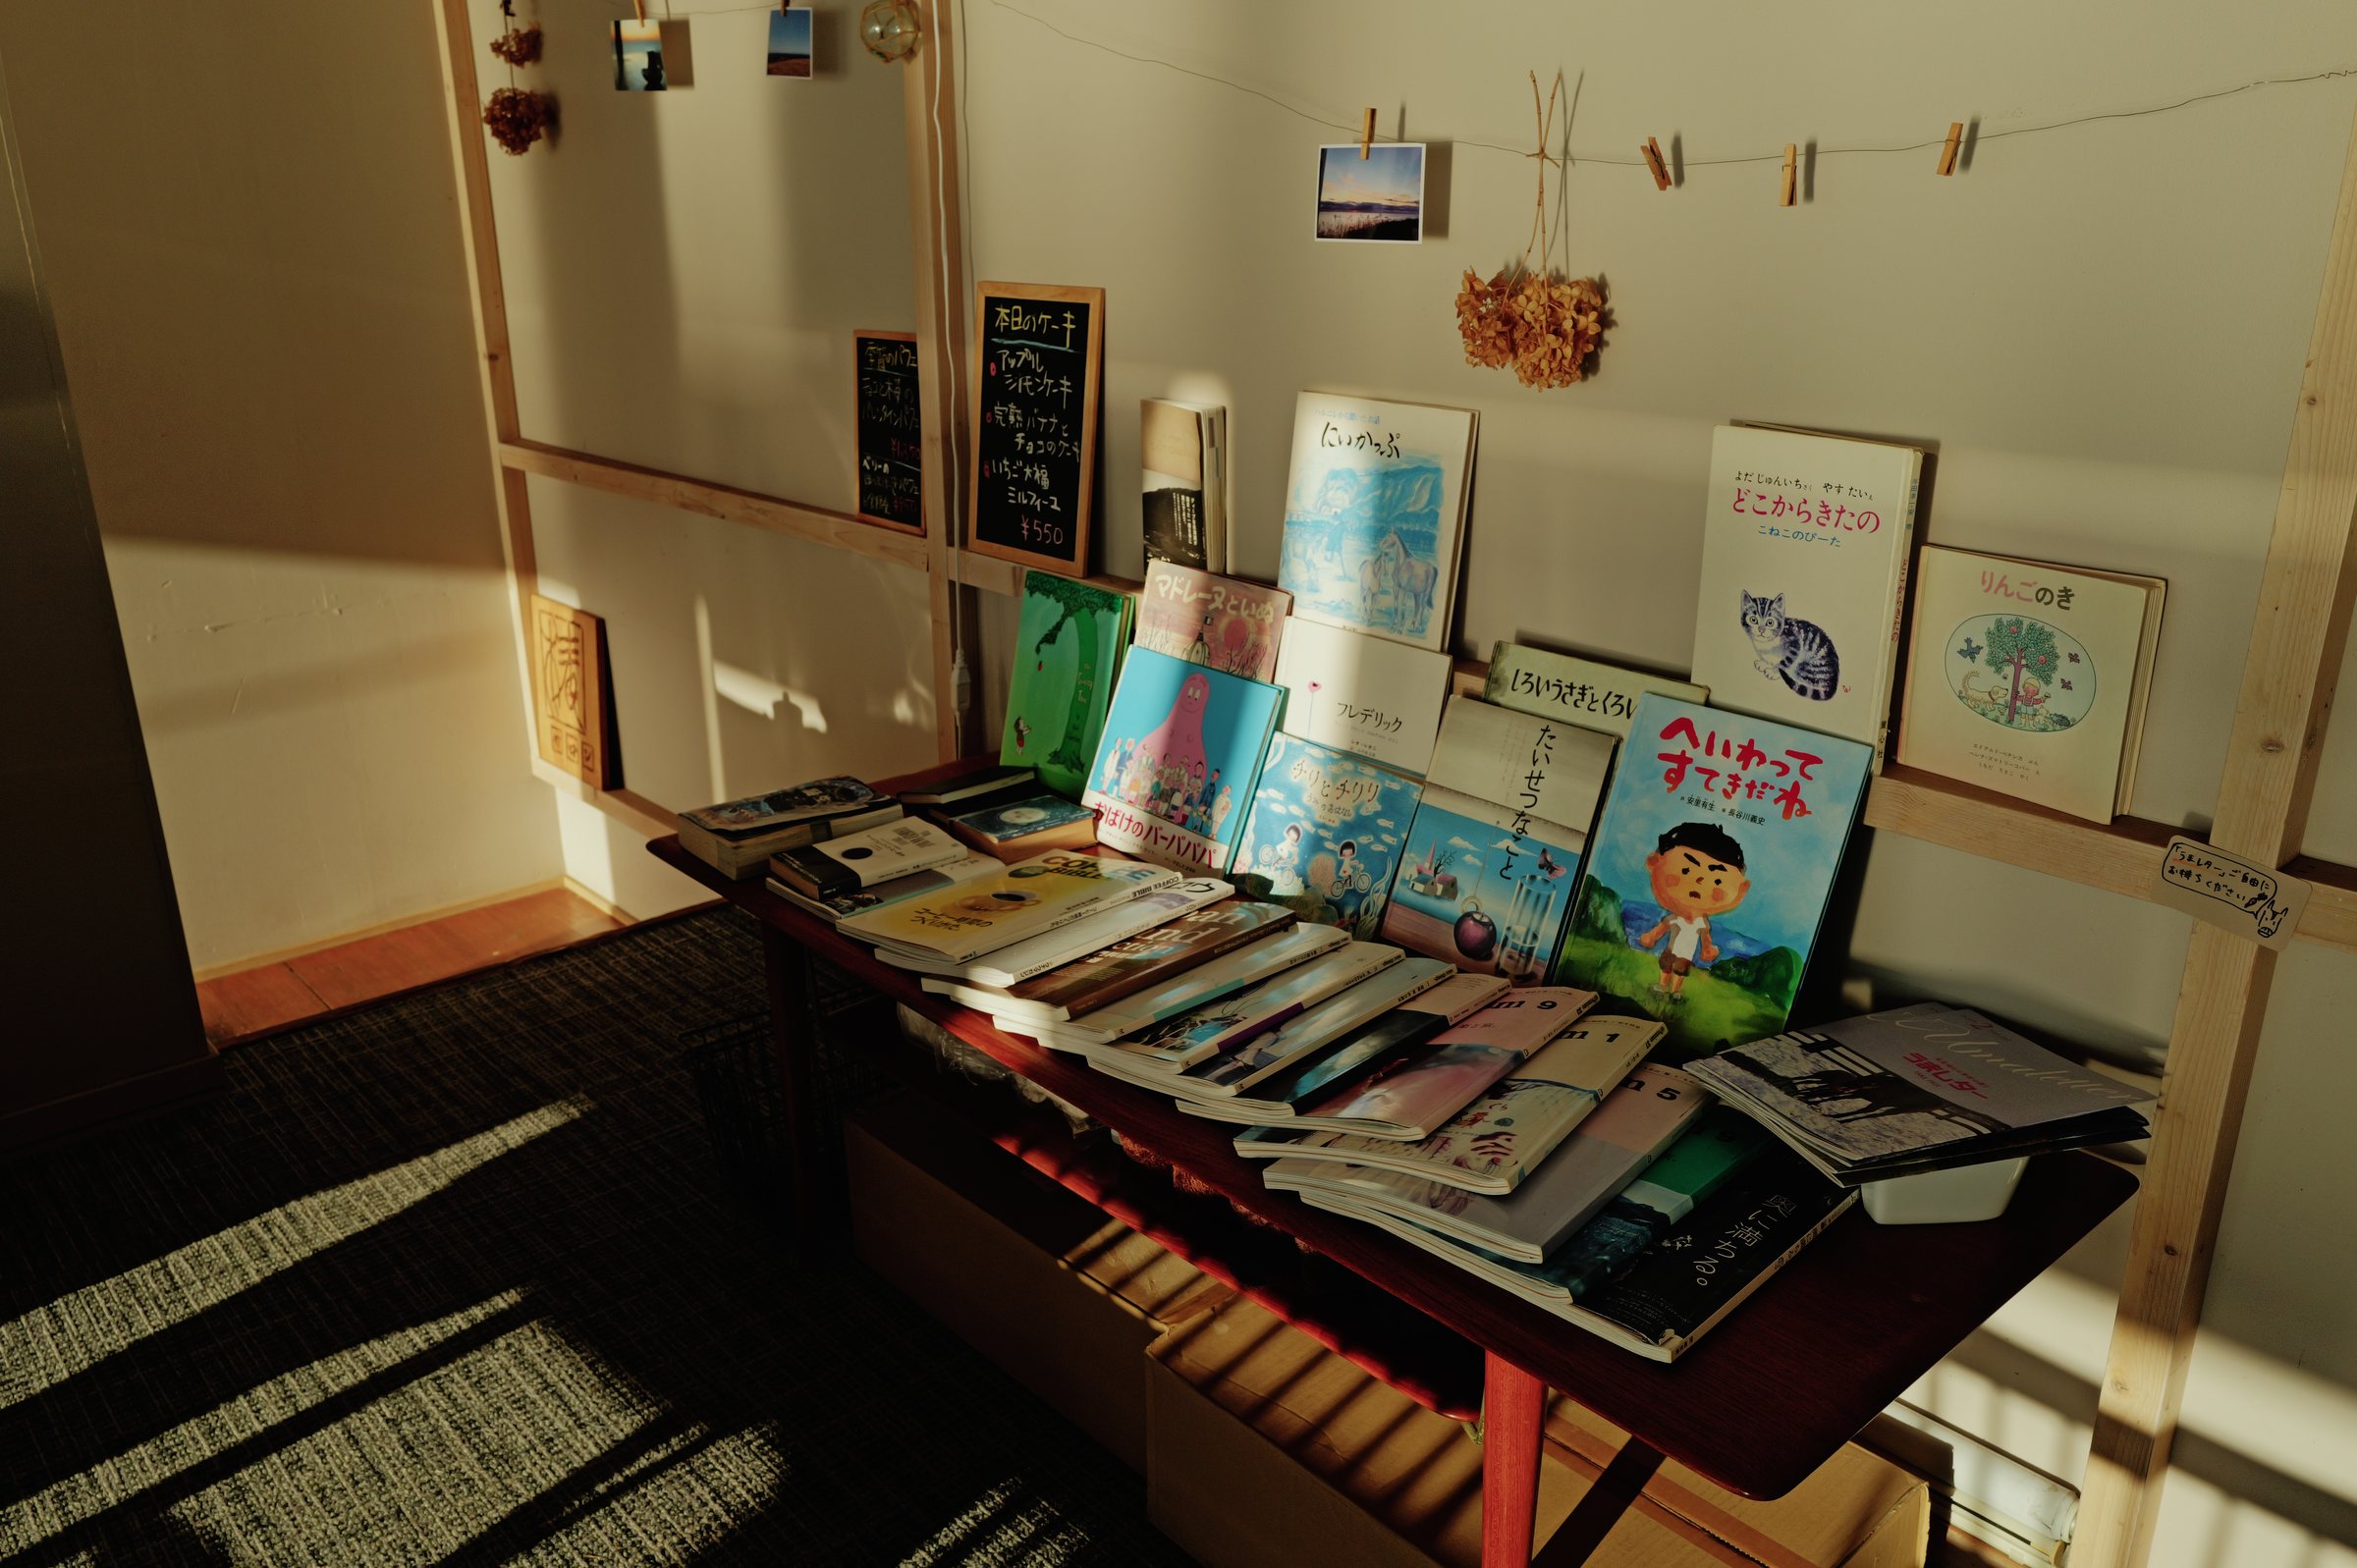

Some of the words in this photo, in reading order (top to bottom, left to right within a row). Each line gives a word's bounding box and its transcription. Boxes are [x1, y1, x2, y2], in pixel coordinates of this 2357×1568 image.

[995, 304, 1076, 349] 本日のケーキ
[996, 348, 1044, 373] アップル
[994, 401, 1069, 438] 完熟バナナと
[1014, 432, 1080, 463] チョコのケーキ
[1321, 422, 1400, 459] にいかっぷ
[992, 457, 1050, 491] いちご大福
[1008, 486, 1062, 513] ミルフィーユ
[1732, 487, 1881, 534] どこからきたの
[1020, 514, 1064, 546] ¥550
[1155, 573, 1275, 623] マドレーヌといぬ
[1981, 569, 2075, 611] りんごのき
[1338, 701, 1402, 733] フレデリック
[1660, 717, 1824, 782] へいわって
[1292, 759, 1380, 803] チリとチリリ
[1657, 749, 1813, 821] すてきだね
[1500, 725, 1558, 881] たいせつなこと
[1153, 876, 1179, 891] COFFEE
[2167, 865, 2246, 902] お持ちください
[1656, 1087, 1681, 1101] 5
